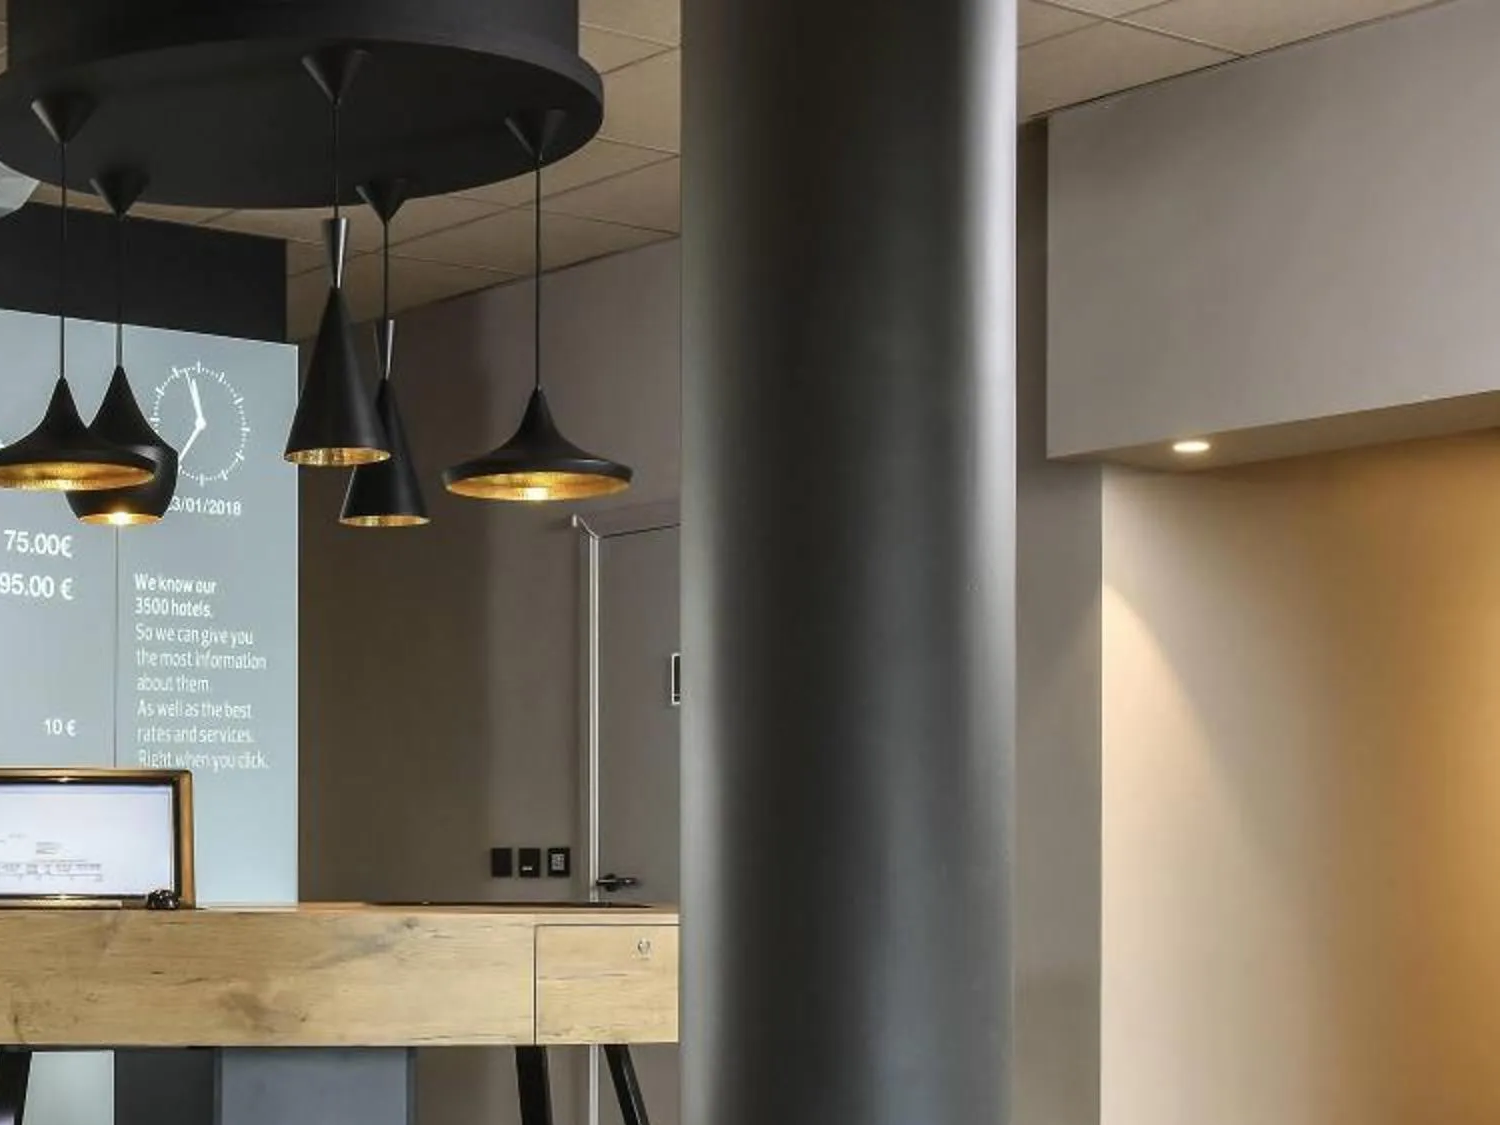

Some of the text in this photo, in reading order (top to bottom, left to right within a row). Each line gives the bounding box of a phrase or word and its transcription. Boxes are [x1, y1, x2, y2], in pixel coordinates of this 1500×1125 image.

[60, 577, 74, 601] €
[134, 572, 218, 595] We know our
[134, 597, 170, 616] 3500
[135, 623, 254, 649] So we can give you
[160, 651, 194, 668] most
[136, 674, 174, 692] about
[137, 700, 155, 717] As
[44, 719, 76, 736] 10 €
